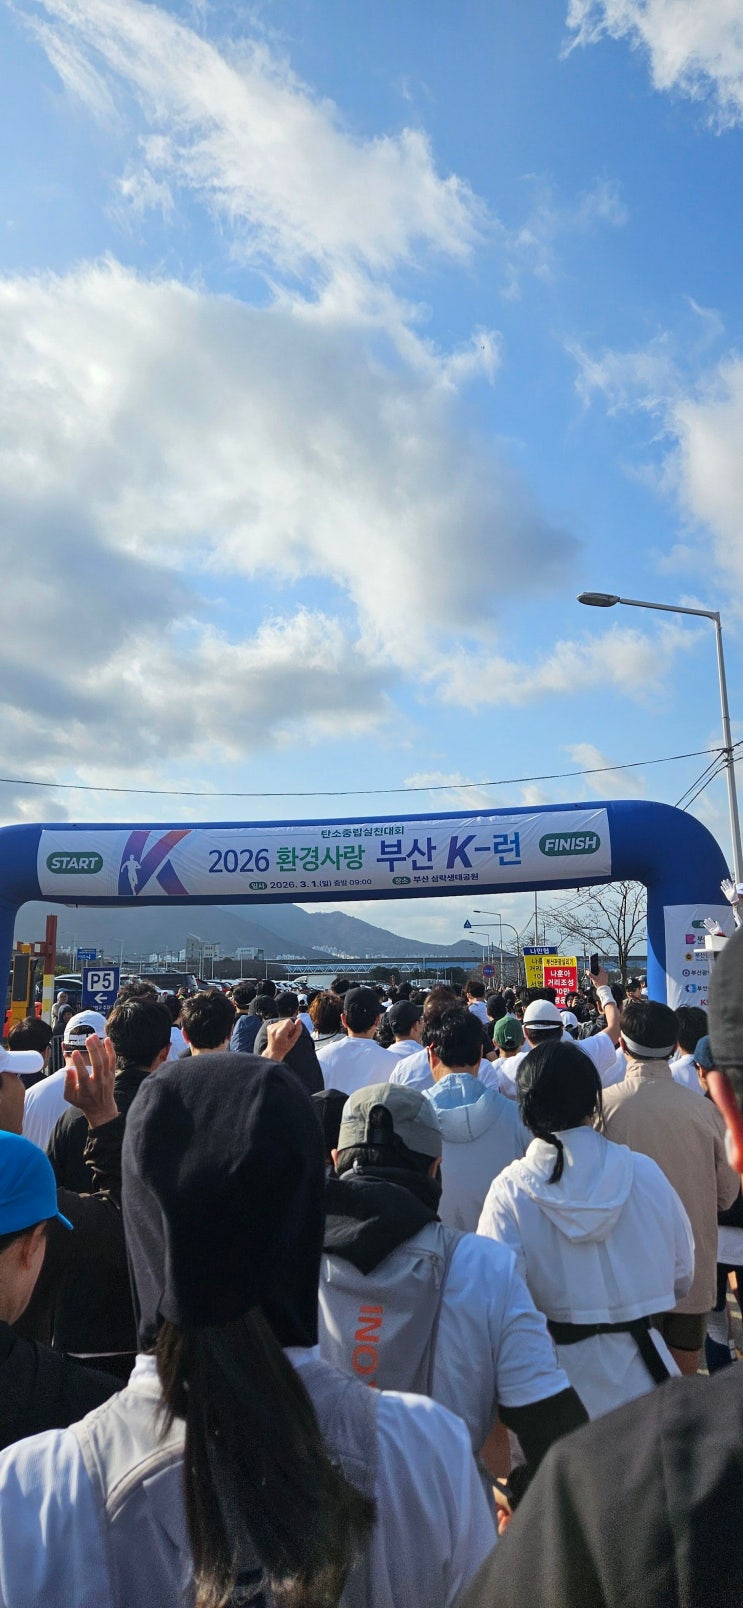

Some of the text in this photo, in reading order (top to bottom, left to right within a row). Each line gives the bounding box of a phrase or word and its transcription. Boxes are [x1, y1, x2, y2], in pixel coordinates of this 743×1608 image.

[321, 825, 405, 839] 탄소중립실천대회
[208, 831, 522, 873] 2026 환경사랑 부산 K-런
[544, 836, 597, 853] FINISH
[51, 857, 98, 870] START
[270, 881, 298, 889] 2026.
[299, 880, 310, 888] 3.
[334, 879, 348, 887] 출발
[349, 878, 372, 886] 09:00
[431, 873, 479, 883] 삼락생태공원
[91, 973, 111, 989] P5
[352, 1305, 384, 1388] INO
